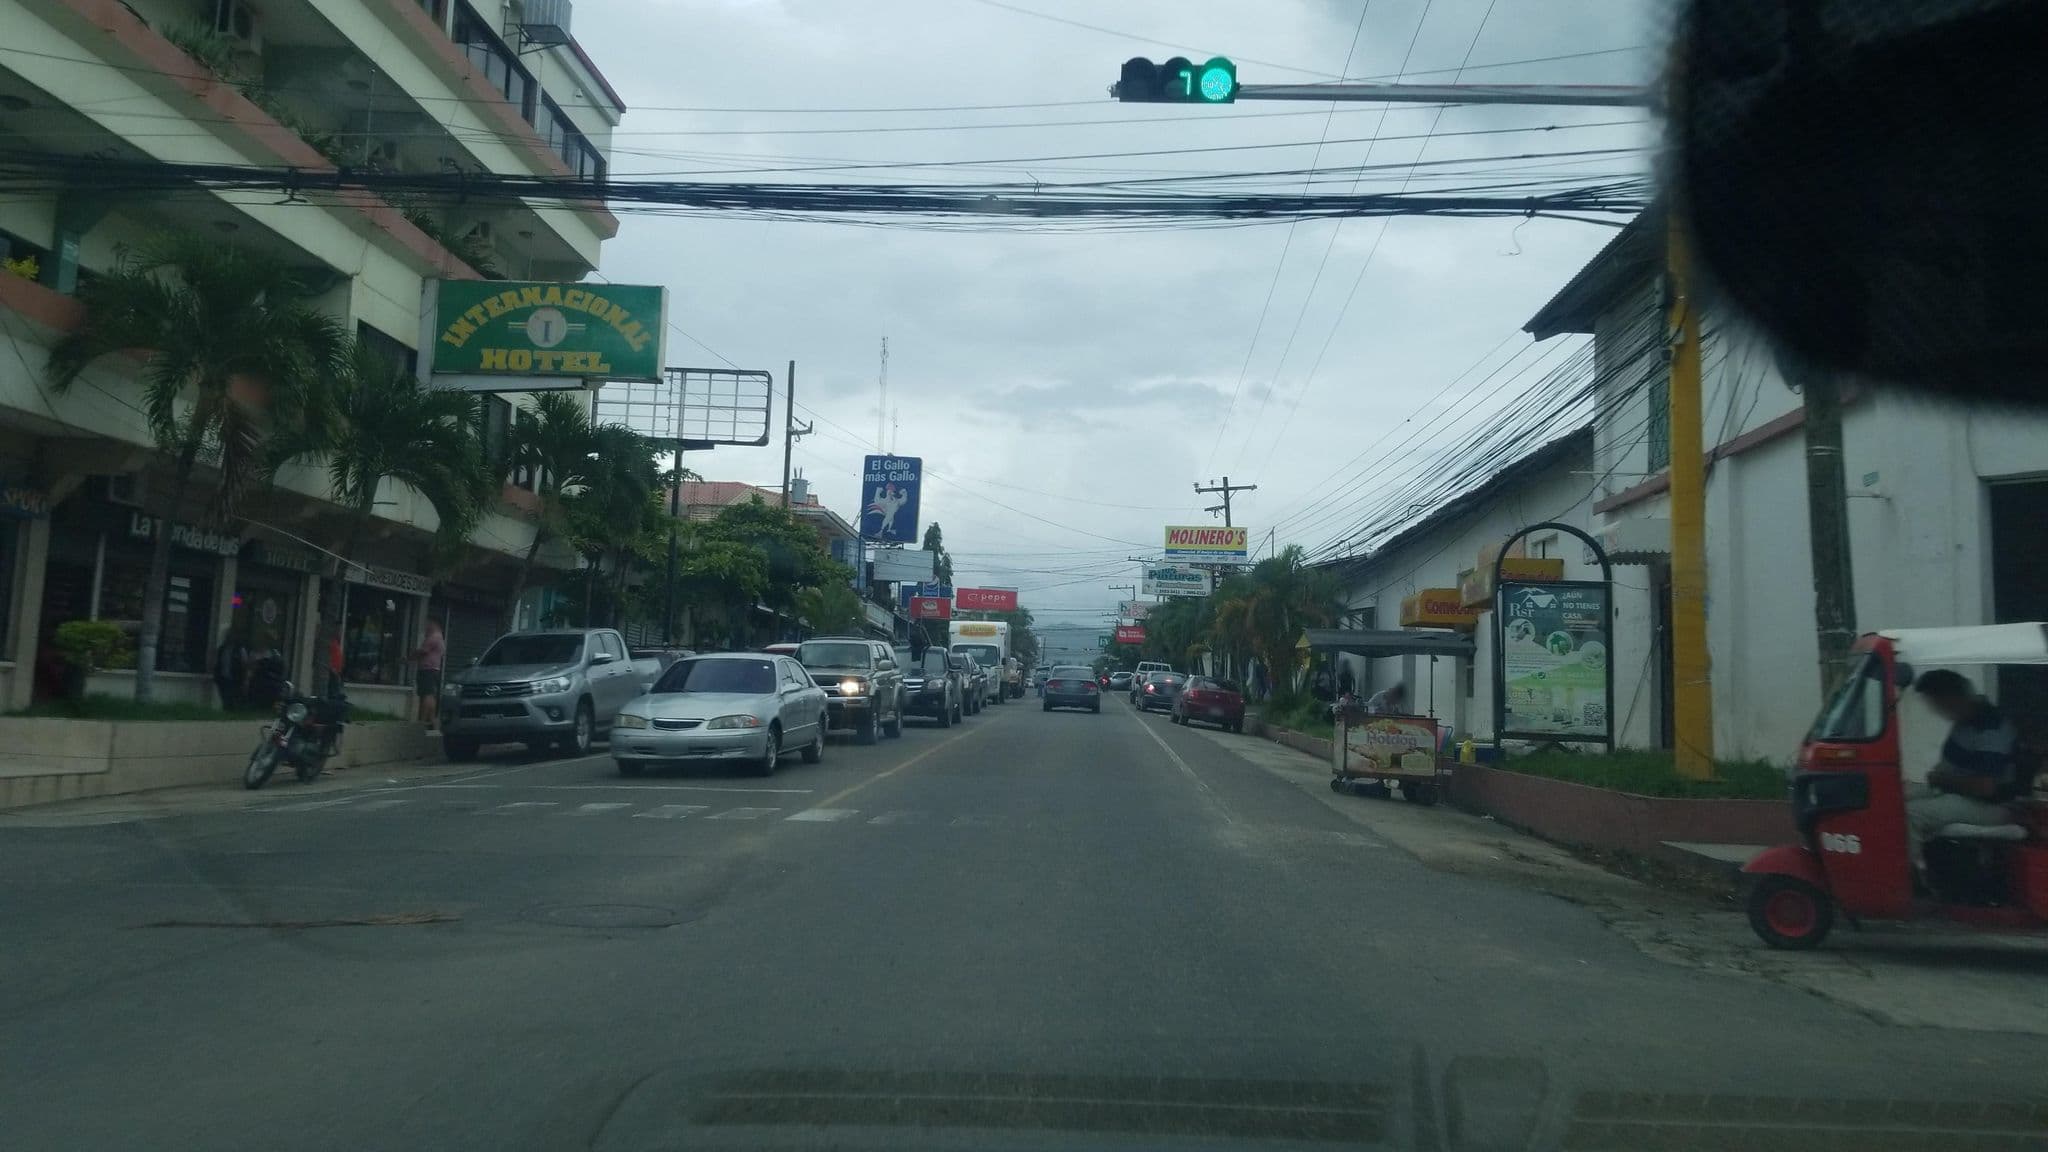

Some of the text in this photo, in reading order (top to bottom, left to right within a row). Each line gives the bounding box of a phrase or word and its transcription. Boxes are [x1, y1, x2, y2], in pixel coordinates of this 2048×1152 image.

[441, 286, 651, 352] INTERNACIONAL
[480, 348, 610, 373] HOTEL
[872, 460, 910, 470] El Gallo
[865, 471, 886, 482] más
[130, 512, 152, 537] La
[1168, 529, 1246, 546] MOLINERO'S
[981, 594, 1007, 602] pepe
